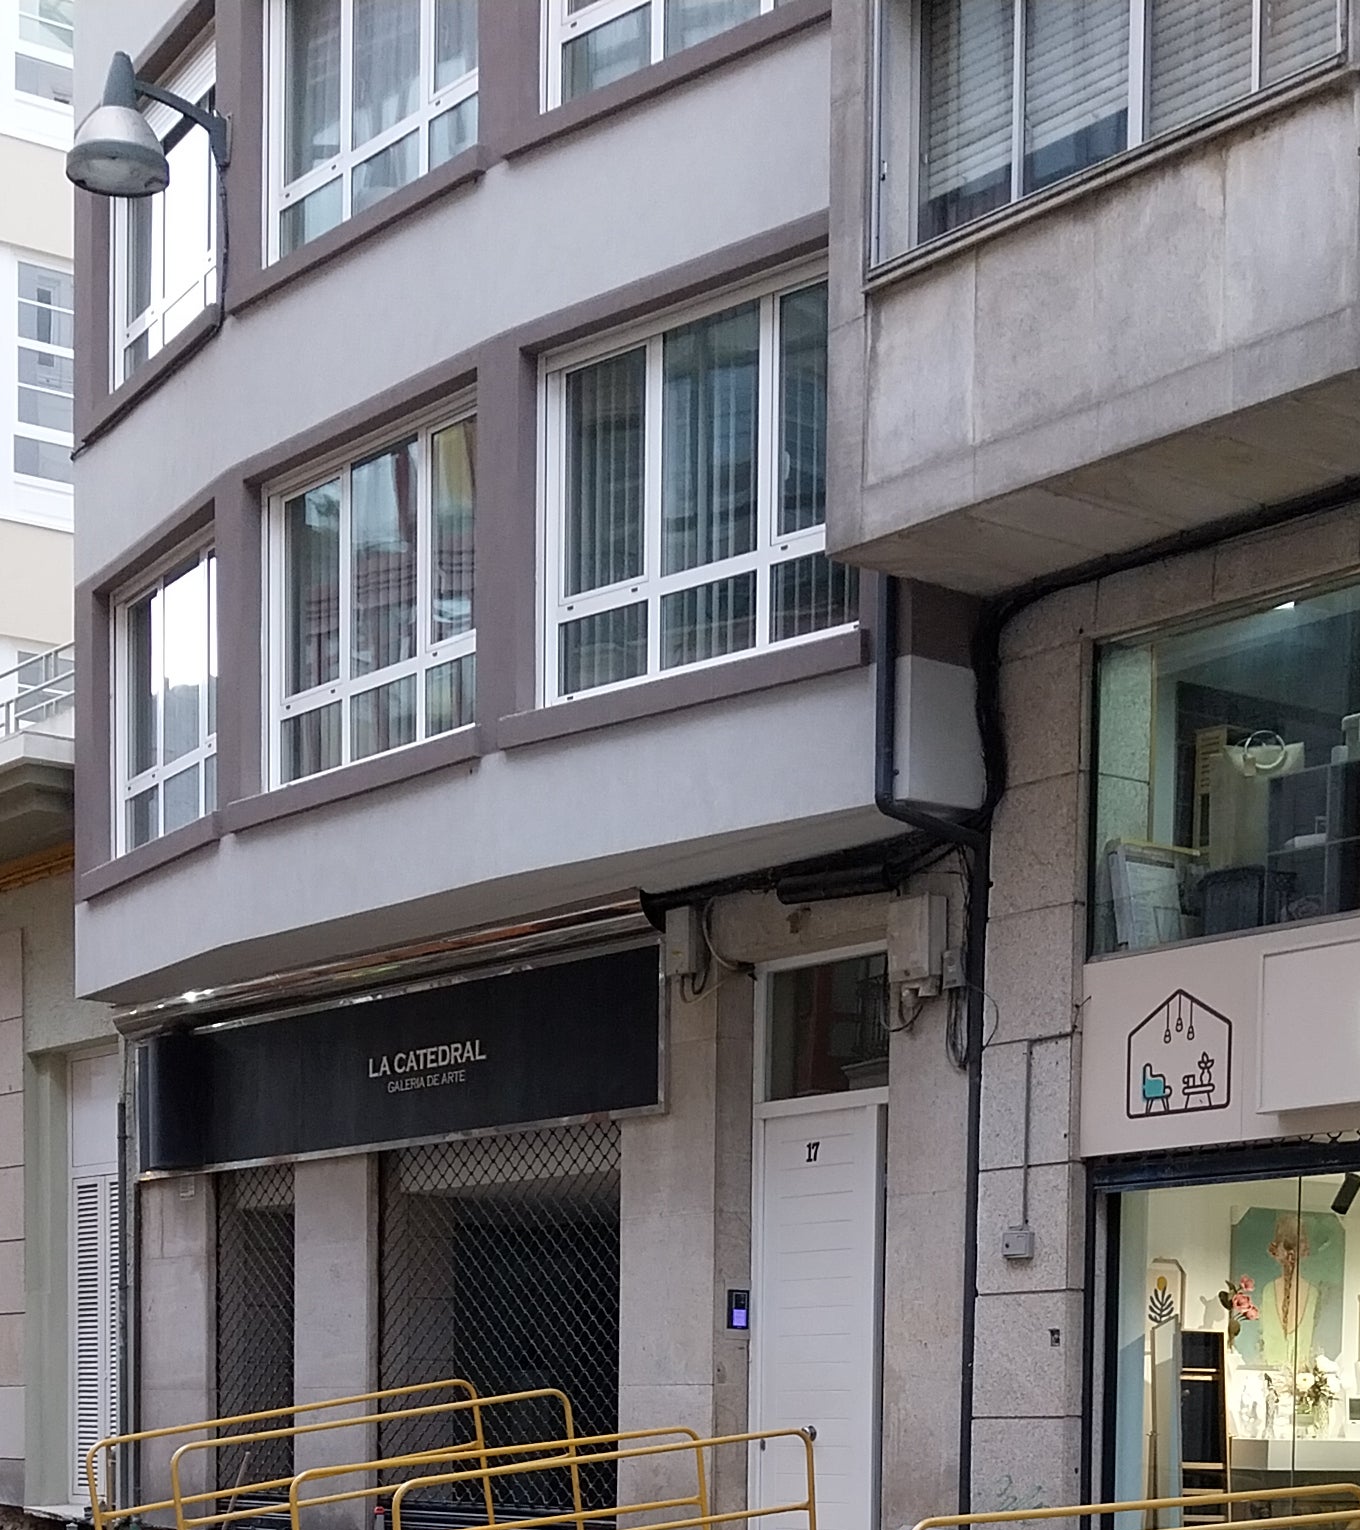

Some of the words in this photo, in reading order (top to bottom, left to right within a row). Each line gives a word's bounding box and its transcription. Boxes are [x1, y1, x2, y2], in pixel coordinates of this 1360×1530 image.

[368, 1056, 392, 1078] LA
[393, 1039, 487, 1073] CATEDRAL
[387, 1076, 426, 1093] GALERIA
[426, 1074, 441, 1087] DE
[441, 1070, 466, 1086] ARTE
[806, 1141, 820, 1163] 17
